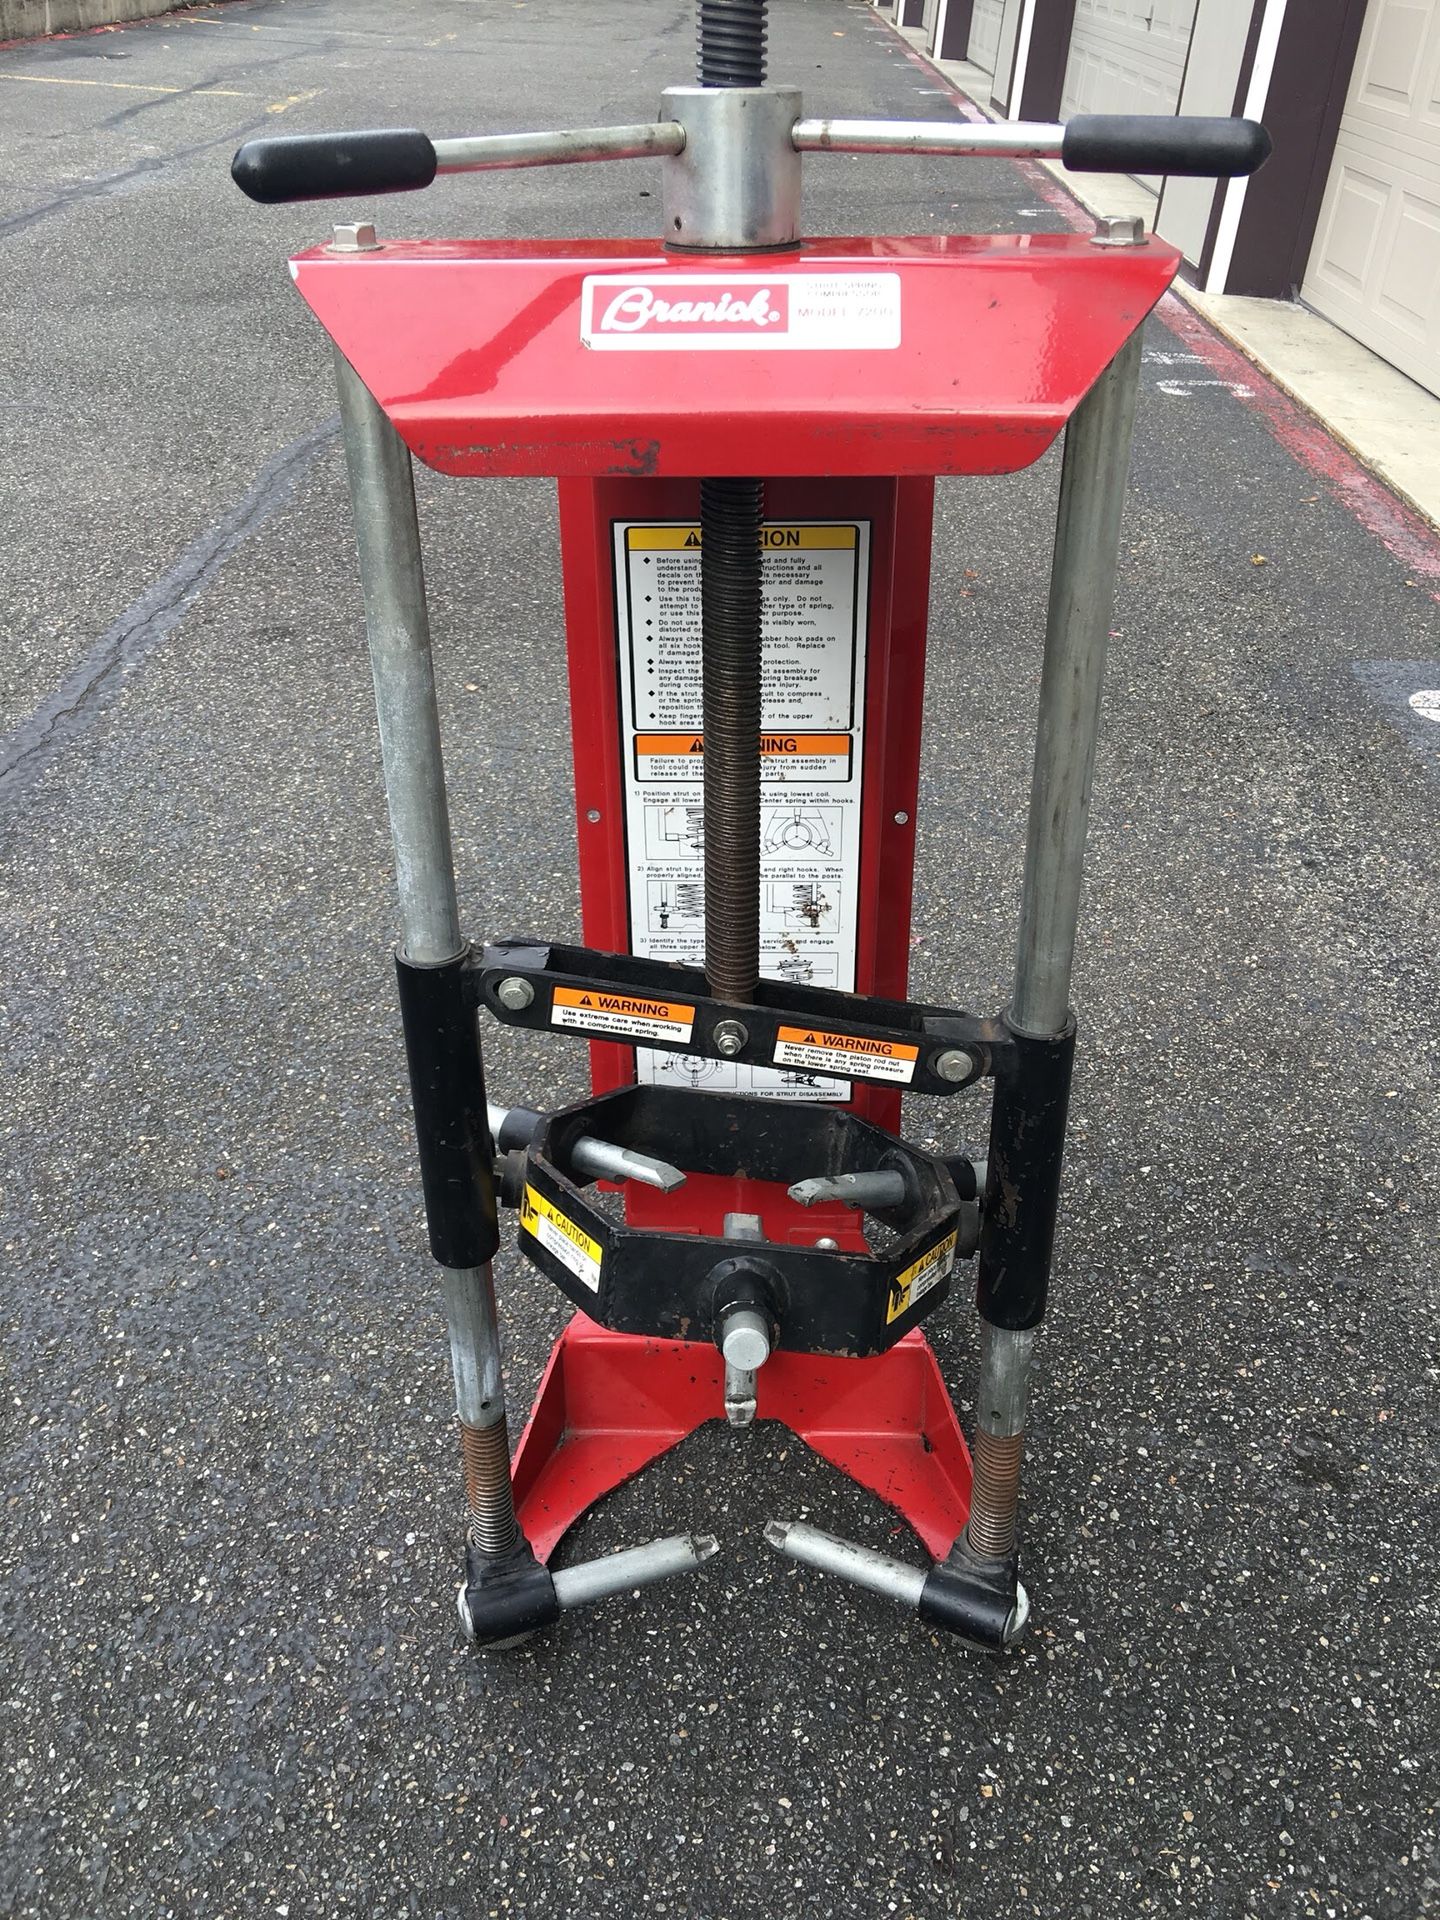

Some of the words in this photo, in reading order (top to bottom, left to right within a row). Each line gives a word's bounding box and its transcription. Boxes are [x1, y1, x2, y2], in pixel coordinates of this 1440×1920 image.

[600, 286, 771, 332] Branick
[790, 557, 806, 565] fully
[598, 996, 670, 1018] WARNING
[562, 1009, 576, 1017] Use
[579, 1012, 610, 1022] extreme
[612, 1016, 628, 1024] care
[631, 1018, 650, 1028] when
[652, 1022, 682, 1033] working
[587, 1020, 632, 1032] compressed
[784, 1043, 805, 1052] Never
[807, 1048, 834, 1057] remove
[836, 1051, 848, 1059] the
[849, 1053, 872, 1063] piston
[874, 1057, 886, 1065] rod
[822, 1034, 893, 1056] WARNING
[784, 1050, 802, 1059] when
[805, 1054, 824, 1062] there
[834, 1059, 846, 1067] any
[849, 1060, 871, 1070] spring
[873, 1065, 904, 1074] pressure
[807, 1060, 827, 1069] lower
[829, 1064, 851, 1073] spring
[556, 1214, 591, 1252] CAUTION
[926, 1234, 954, 1266] CAUTION
